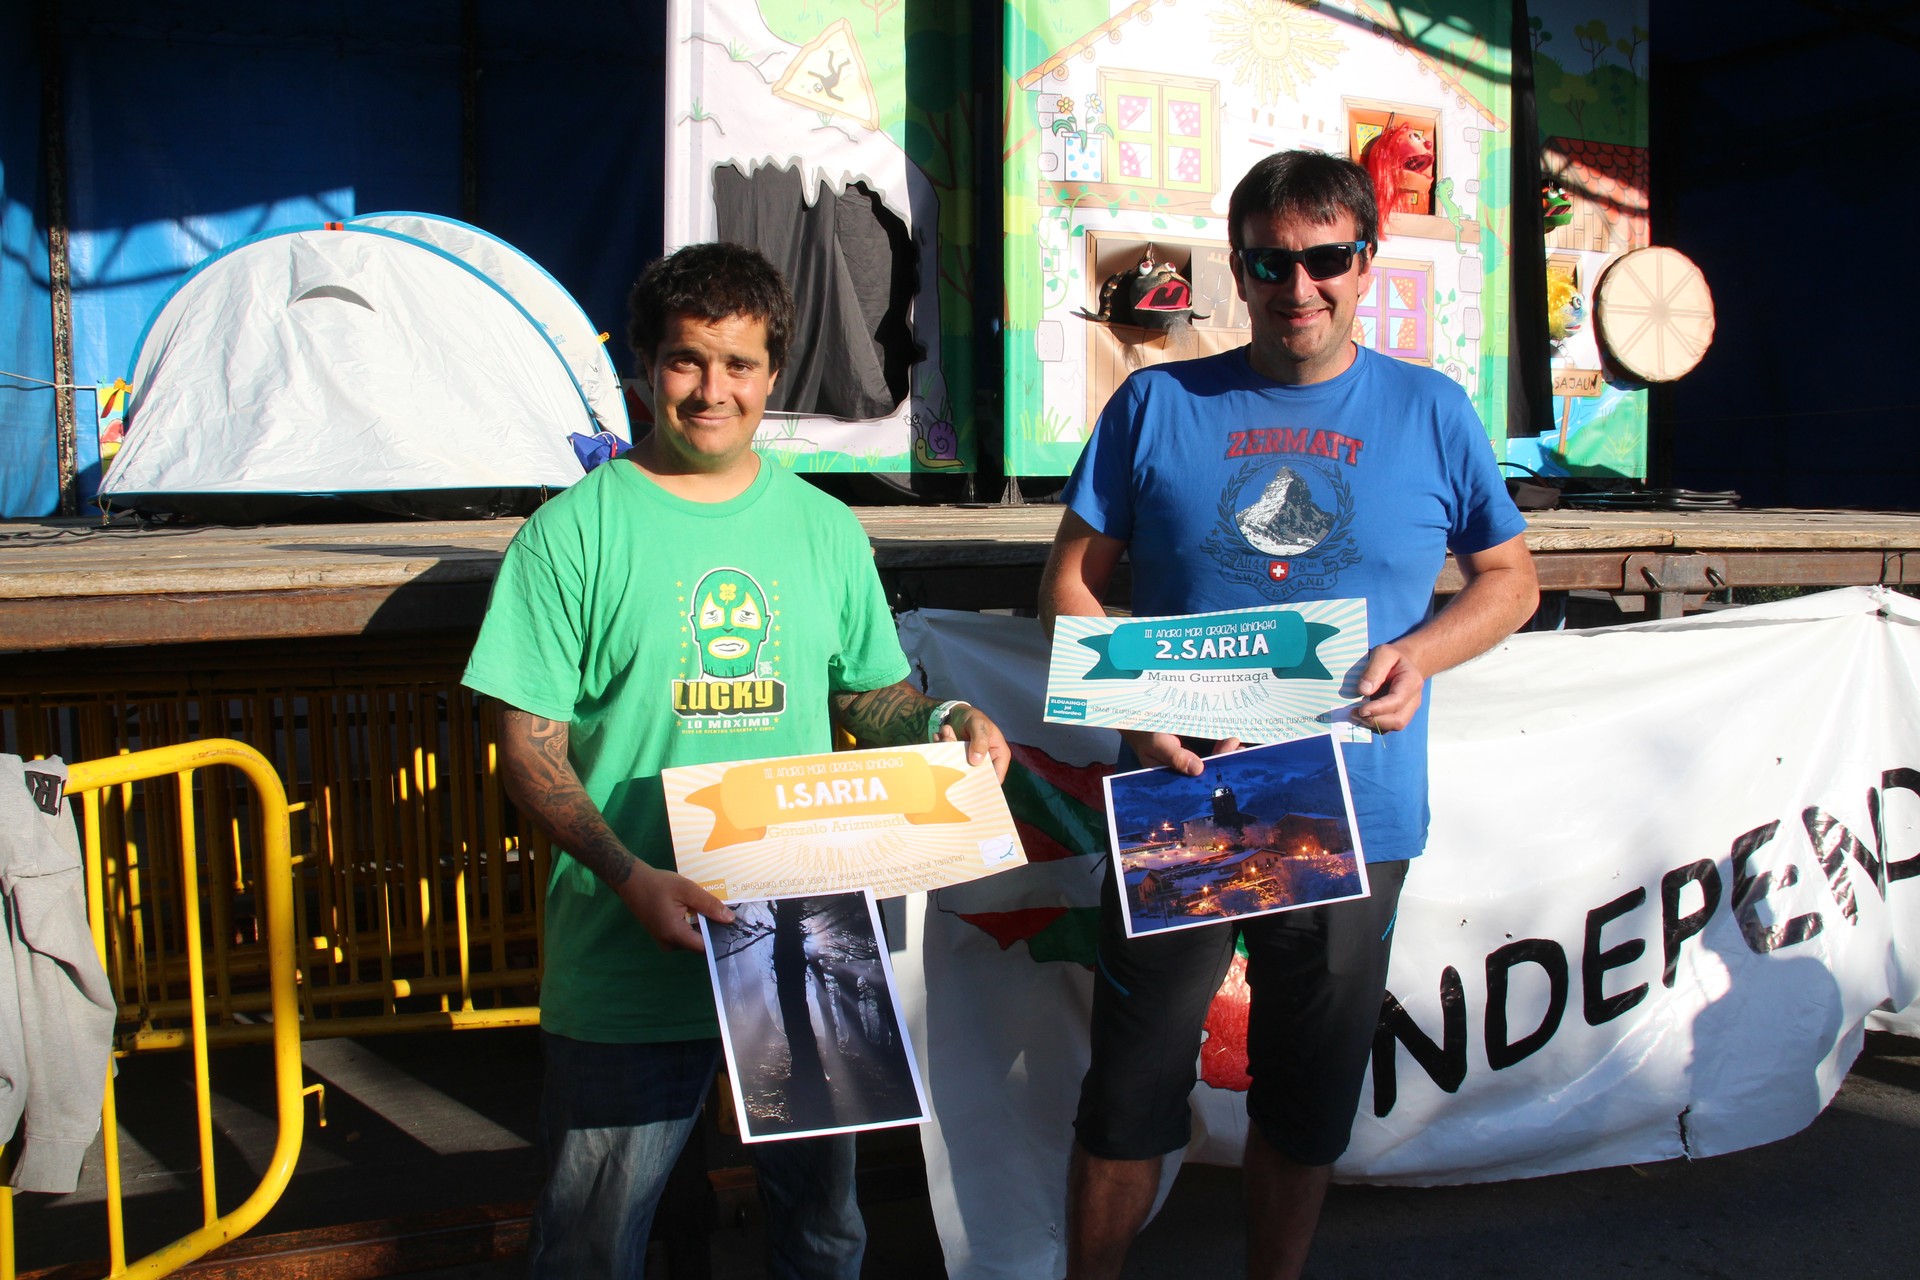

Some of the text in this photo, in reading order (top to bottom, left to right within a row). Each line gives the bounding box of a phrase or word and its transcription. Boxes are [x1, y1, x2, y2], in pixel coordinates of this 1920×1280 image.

[1553, 374, 1598, 390] SAJAUN
[1224, 427, 1364, 466] ZERMATT
[1234, 572, 1325, 598] SWITZERLAND
[1155, 633, 1269, 660] 2.SARIA
[1148, 671, 1269, 684] Manu Gurrutxaga
[674, 680, 775, 711] LUCKY
[1051, 698, 1087, 707] ELDUAINGO
[687, 717, 770, 729] LO MAXIMO
[768, 814, 906, 839] Gonzalo Arizmendi
[732, 883, 738, 892] 5
[1371, 767, 1920, 1118] NDEPEND
